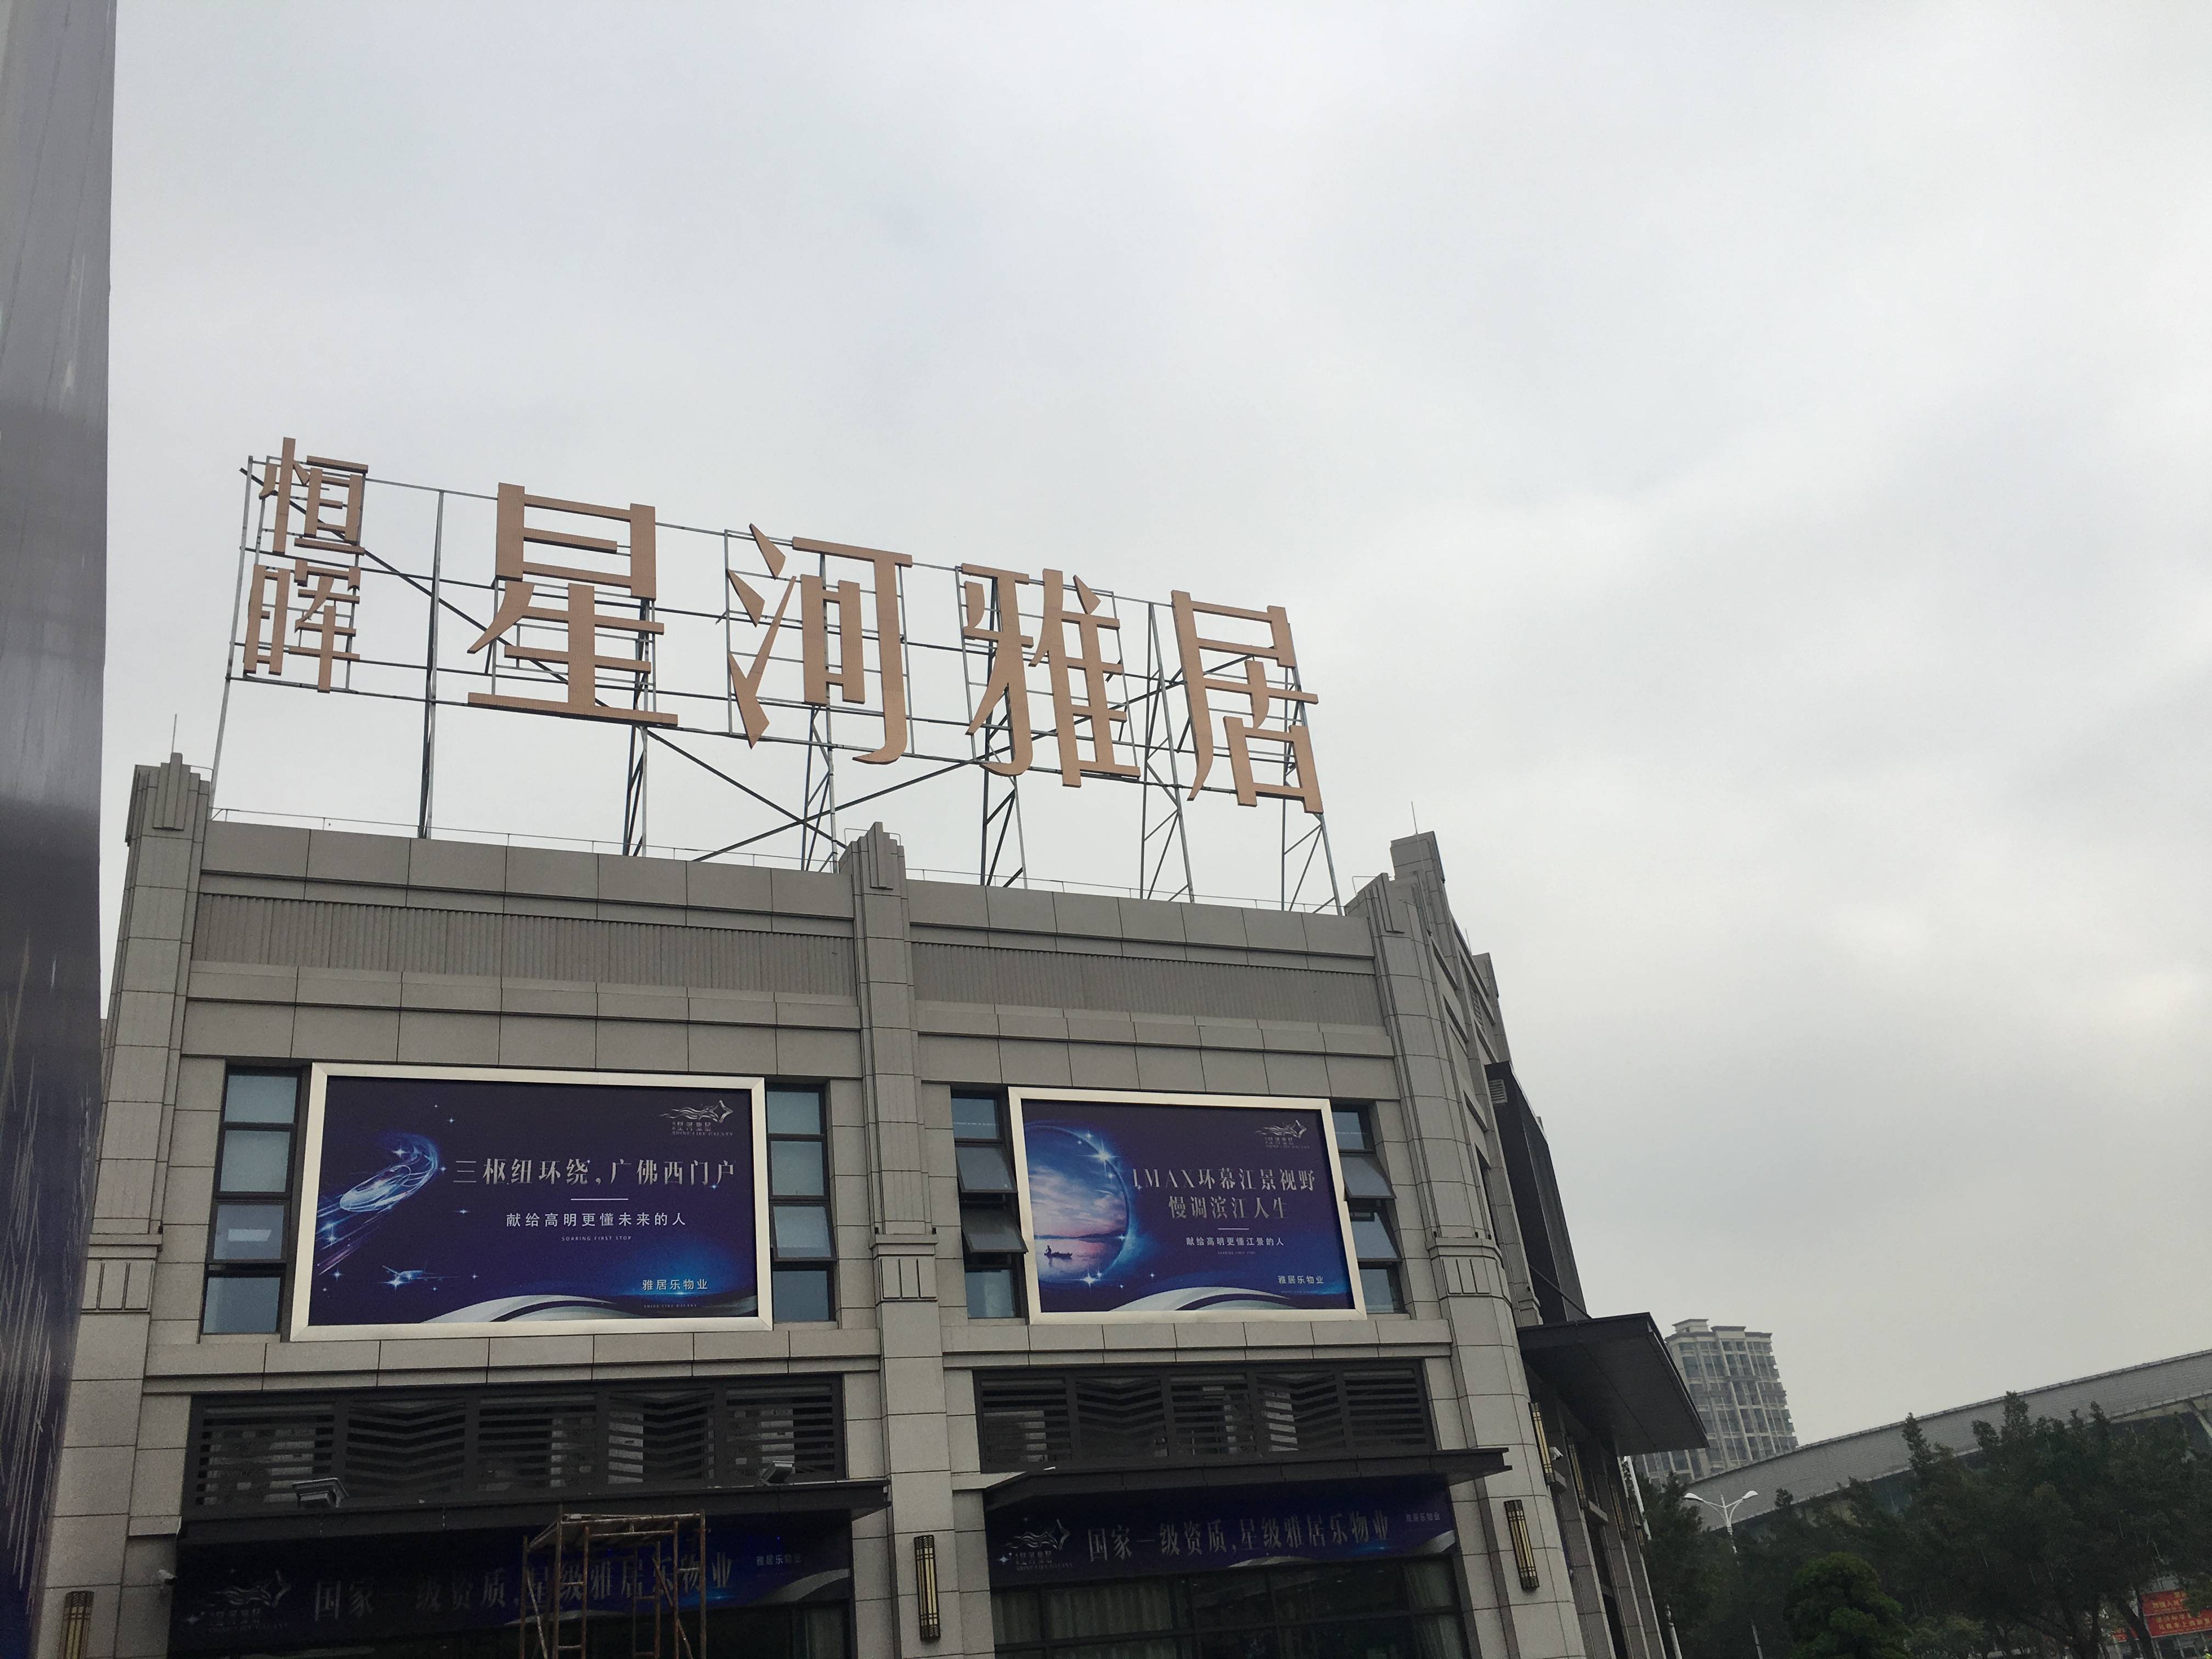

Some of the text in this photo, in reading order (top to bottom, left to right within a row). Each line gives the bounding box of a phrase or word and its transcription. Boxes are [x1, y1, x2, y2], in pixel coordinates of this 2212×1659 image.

[467, 482, 1323, 814] 星河雅居
[1168, 1195, 1289, 1219] 慢调滨江人生
[506, 1212, 686, 1227] 献给高明更懂未来的人
[1186, 1237, 1284, 1246] 献给高明更懂江景的人
[642, 1279, 708, 1291] 雅居乐物业
[1277, 1275, 1324, 1284] 雅居乐物业
